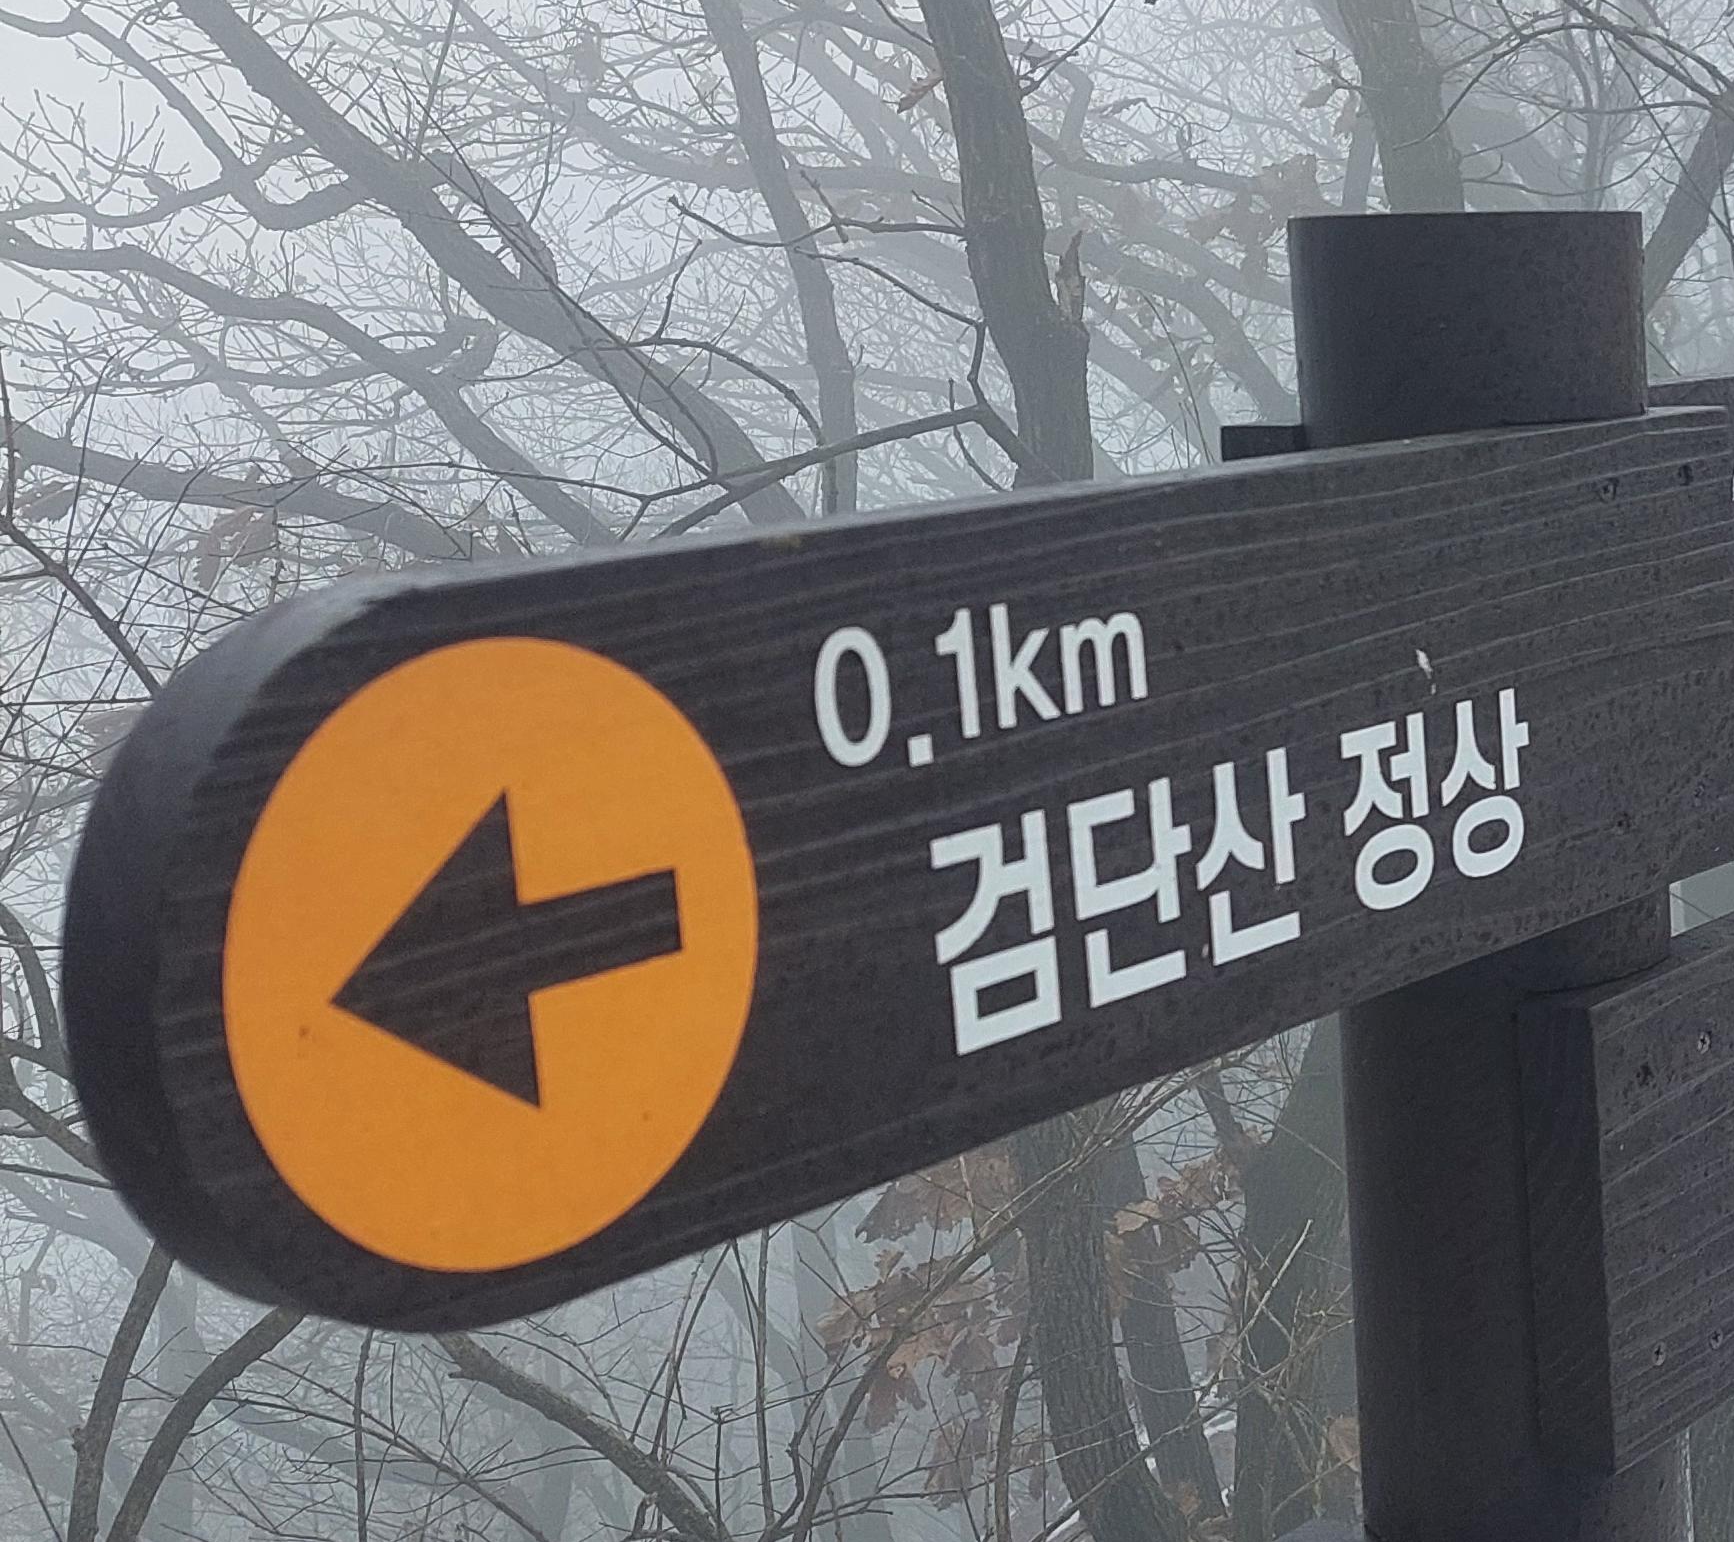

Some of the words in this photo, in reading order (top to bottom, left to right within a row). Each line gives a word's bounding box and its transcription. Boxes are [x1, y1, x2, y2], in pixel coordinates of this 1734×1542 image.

[815, 604, 1148, 766] 0.1km
[931, 747, 1306, 1055] 검단산
[1340, 688, 1530, 910] 정상
